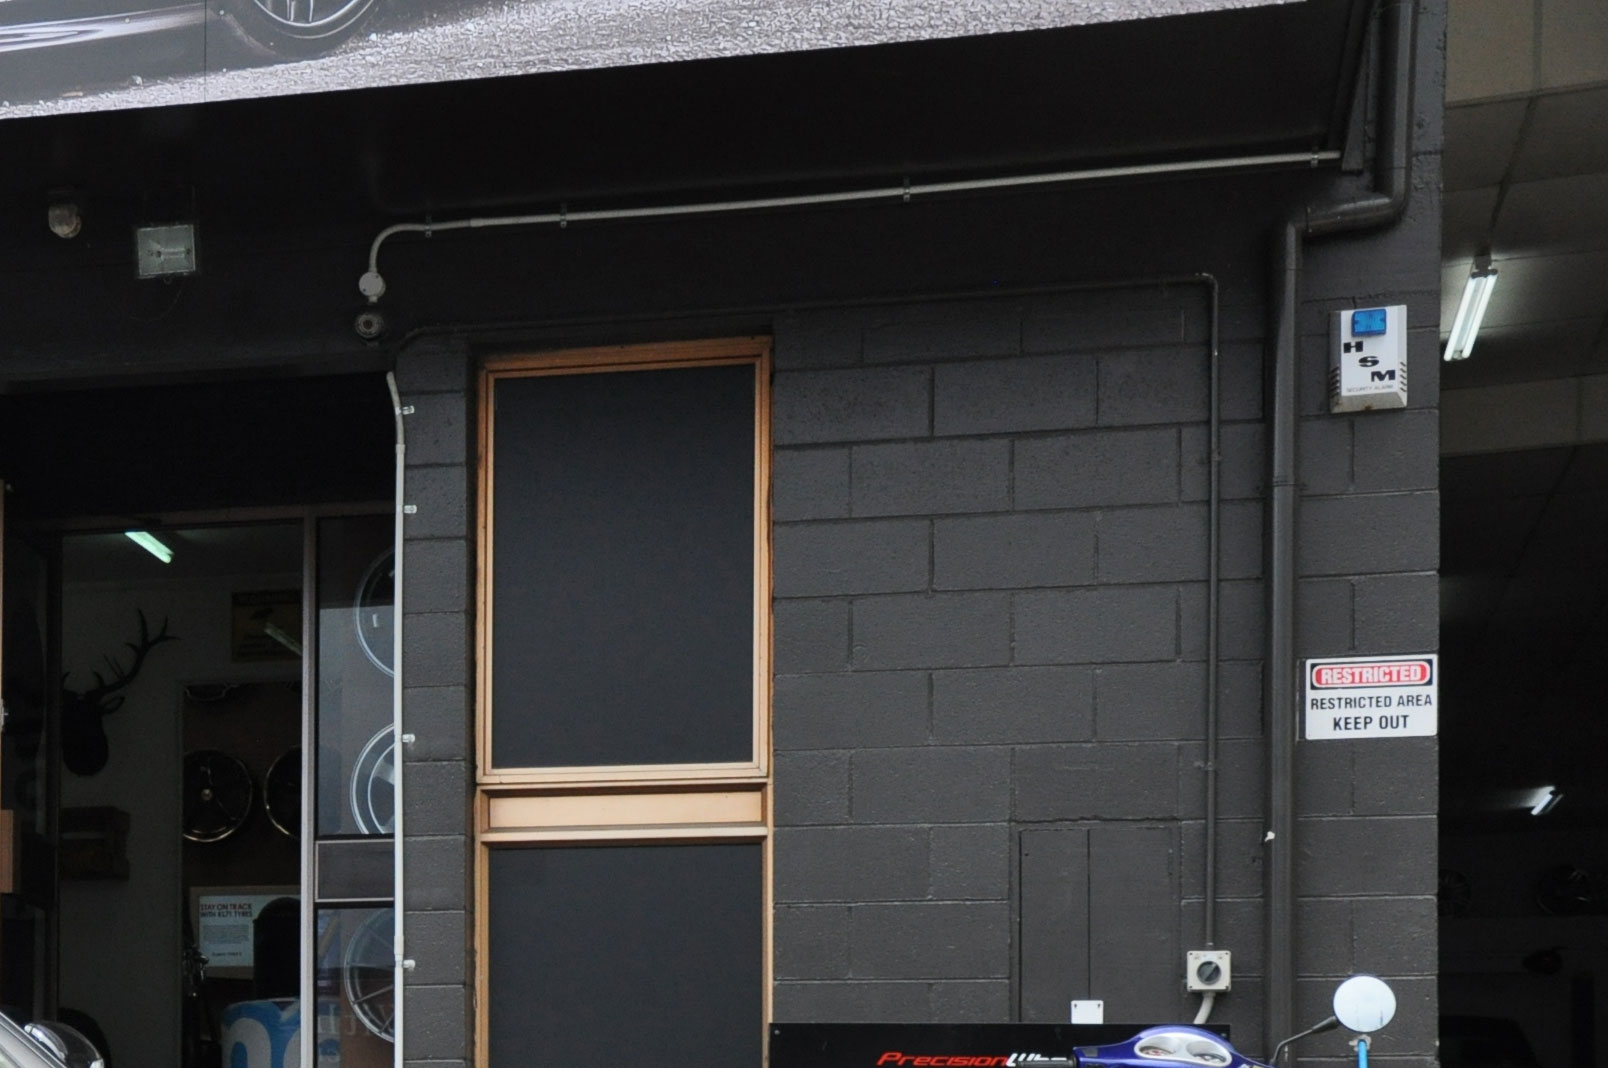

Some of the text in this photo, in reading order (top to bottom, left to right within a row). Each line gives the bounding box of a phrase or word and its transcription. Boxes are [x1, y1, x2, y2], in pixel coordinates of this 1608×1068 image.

[1320, 663, 1422, 685] RESTRICTED
[1310, 694, 1433, 710] RESTRICTED AREA
[1333, 715, 1410, 731] KEEP OUT
